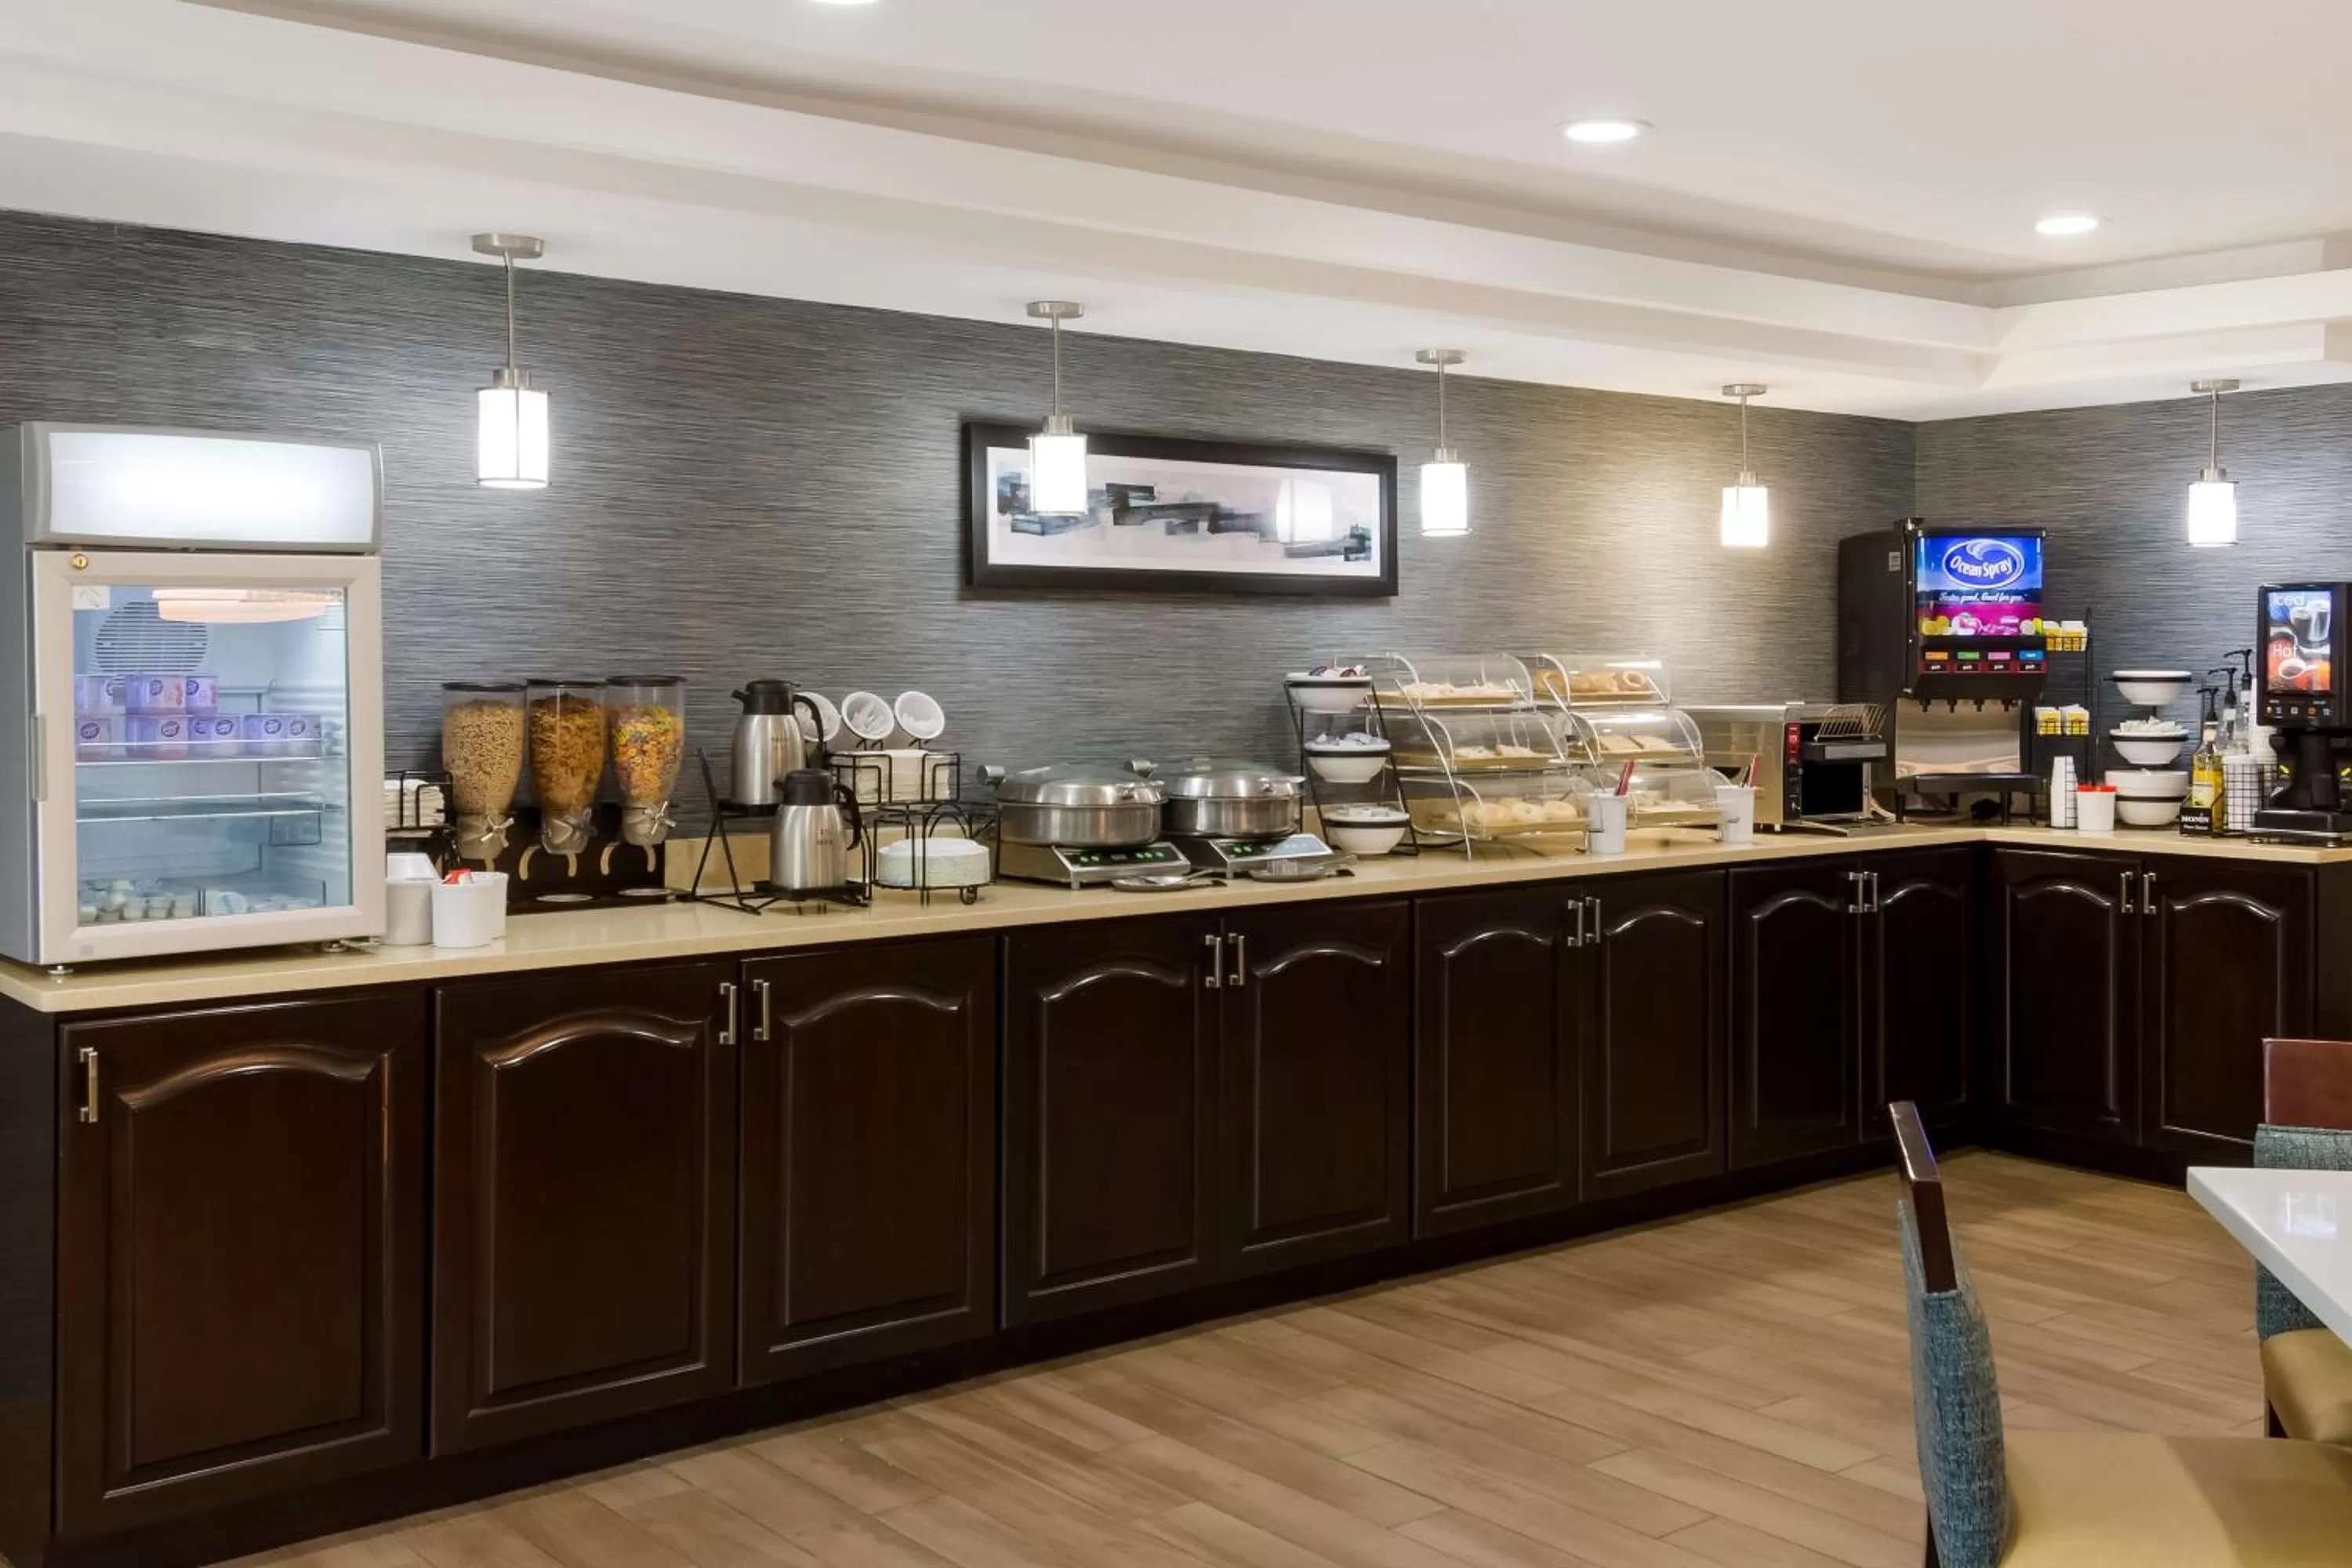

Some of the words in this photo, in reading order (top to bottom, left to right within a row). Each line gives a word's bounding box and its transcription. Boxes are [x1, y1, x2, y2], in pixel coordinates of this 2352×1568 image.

[1950, 556, 1981, 578] Ocean
[1983, 557, 2013, 579] Spray
[2273, 644, 2298, 659] Hot
